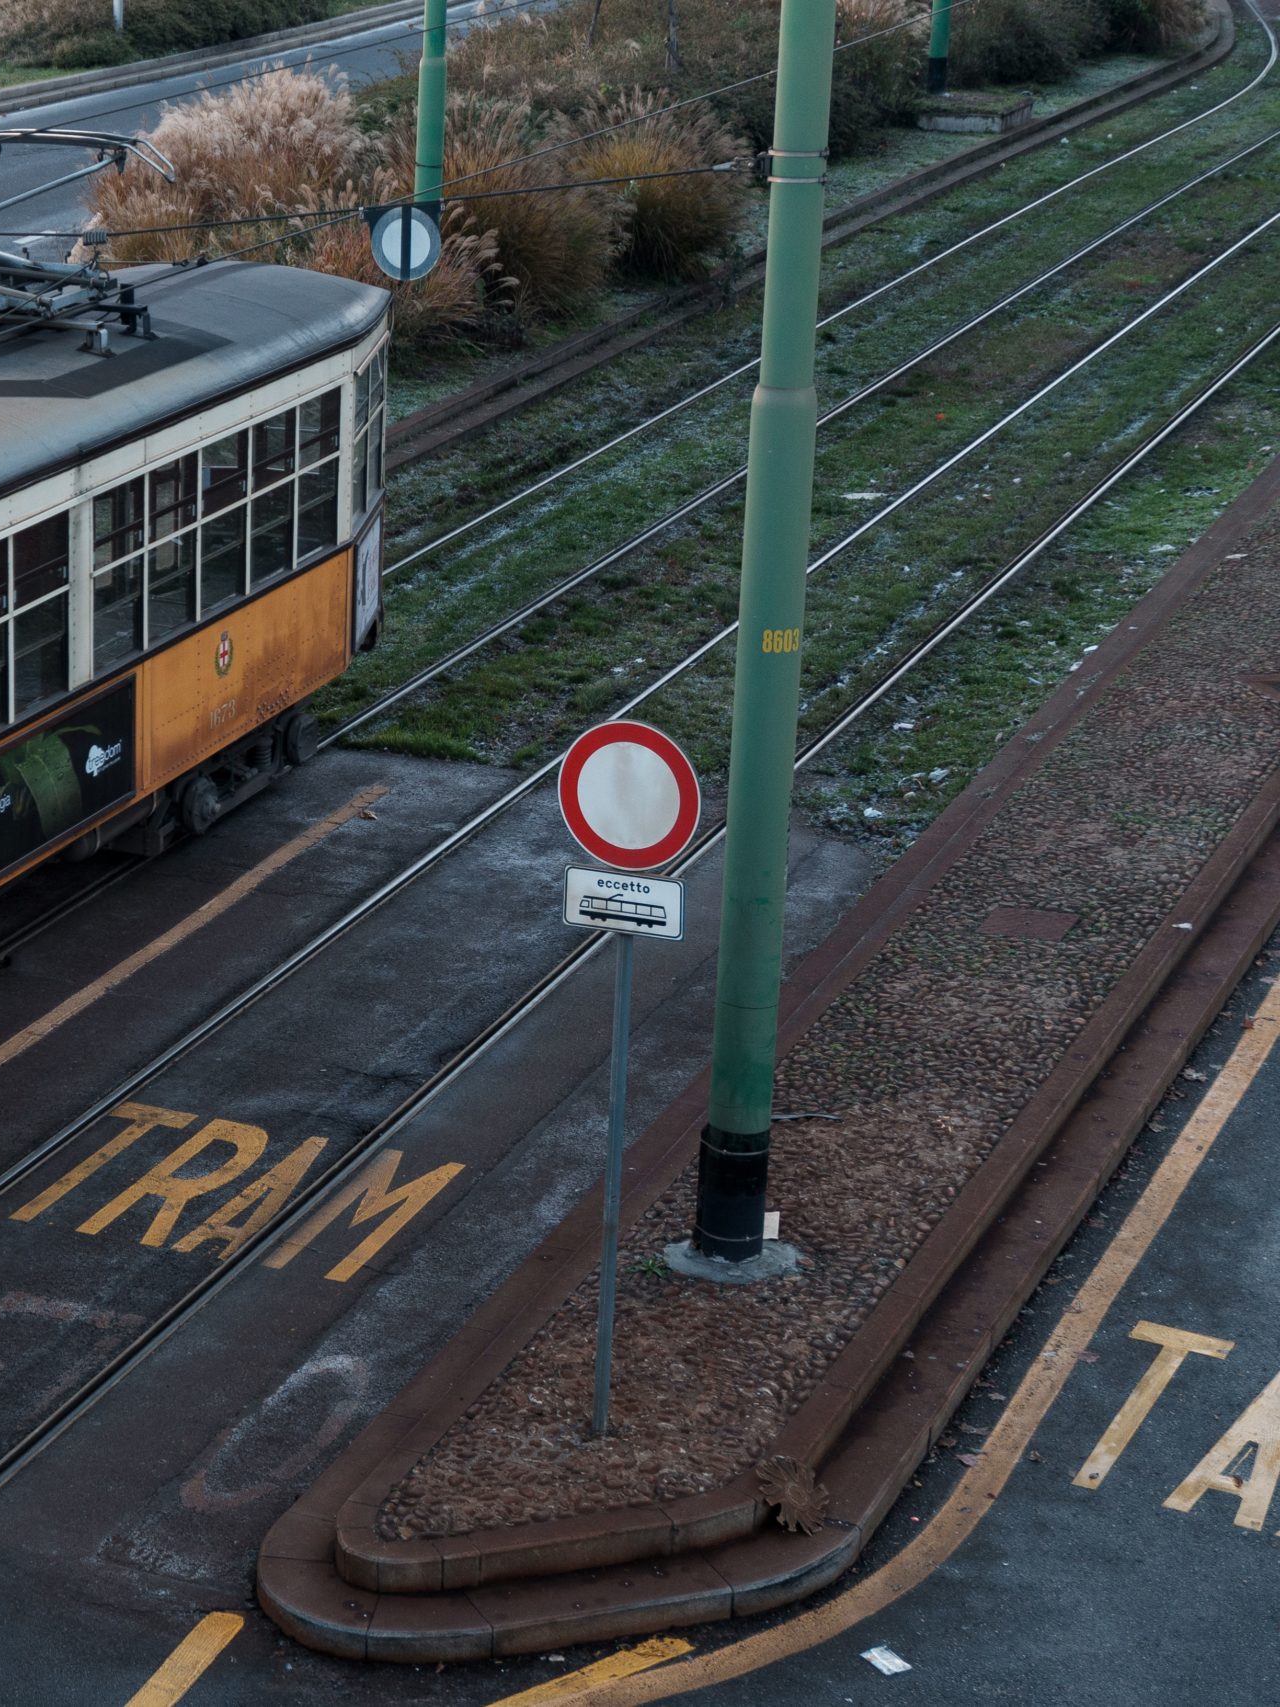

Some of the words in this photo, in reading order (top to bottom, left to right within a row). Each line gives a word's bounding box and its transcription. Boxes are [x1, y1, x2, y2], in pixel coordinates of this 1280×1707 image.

[762, 628, 800, 653] 8603
[210, 699, 236, 729] 1673
[597, 879, 650, 894] eccetto
[9, 1101, 466, 1283] TRAM
